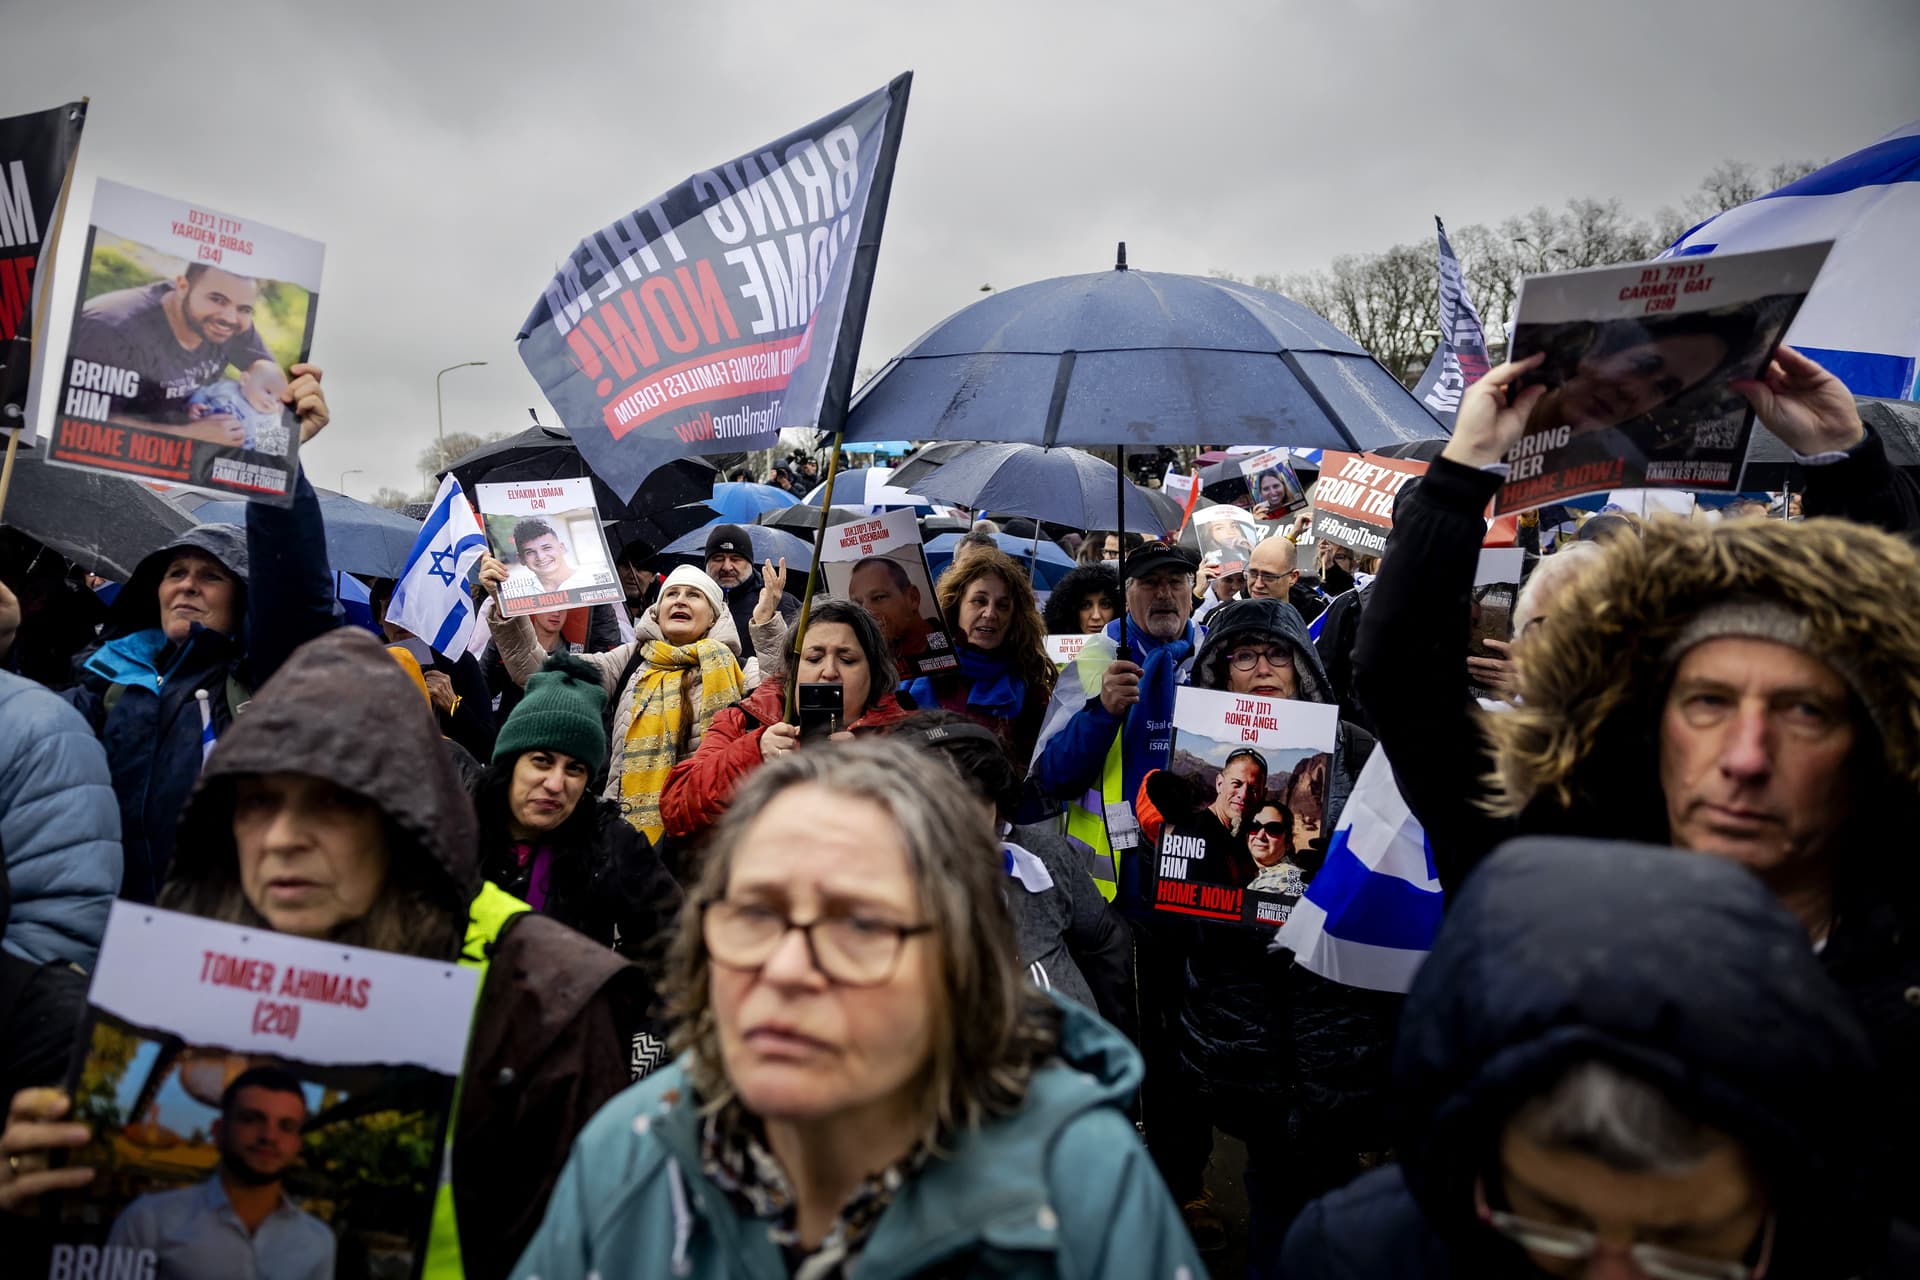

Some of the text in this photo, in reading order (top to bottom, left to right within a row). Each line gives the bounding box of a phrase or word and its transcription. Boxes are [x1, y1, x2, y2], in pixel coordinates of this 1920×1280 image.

[172, 221, 254, 256] YARDEN BIBAS
[198, 244, 222, 264] (34)
[1618, 277, 1714, 301] CARMEL GAT
[69, 358, 140, 398] BRING
[64, 387, 111, 422] HIM
[60, 419, 126, 457] HOME
[128, 431, 193, 469] NOW!
[1508, 425, 1571, 462] BRING
[1338, 456, 1393, 487] THEY
[1502, 456, 1624, 505] HOME NOW!
[1504, 454, 1544, 484] HER
[1645, 467, 1730, 483] FAMILIES FORUM
[508, 487, 564, 500] ELYAKIM LIBMAN
[531, 498, 546, 510] (24)
[1314, 476, 1367, 509] FROM
[840, 536, 859, 548] MICHEL
[505, 596, 537, 610] HOME
[538, 590, 570, 606] NOW!
[1146, 719, 1166, 731] Sjaal
[1225, 712, 1279, 731] RONEN ANGEL
[1241, 727, 1259, 743] (54)
[1162, 833, 1206, 859] BRING
[1159, 855, 1188, 880] HIM
[1157, 879, 1243, 913] HOME NOW!
[1256, 908, 1287, 922] FAMILIES
[201, 949, 373, 1010] TOMER AHIMAS
[252, 1000, 301, 1041] (20)
[49, 1244, 157, 1280] BRING
